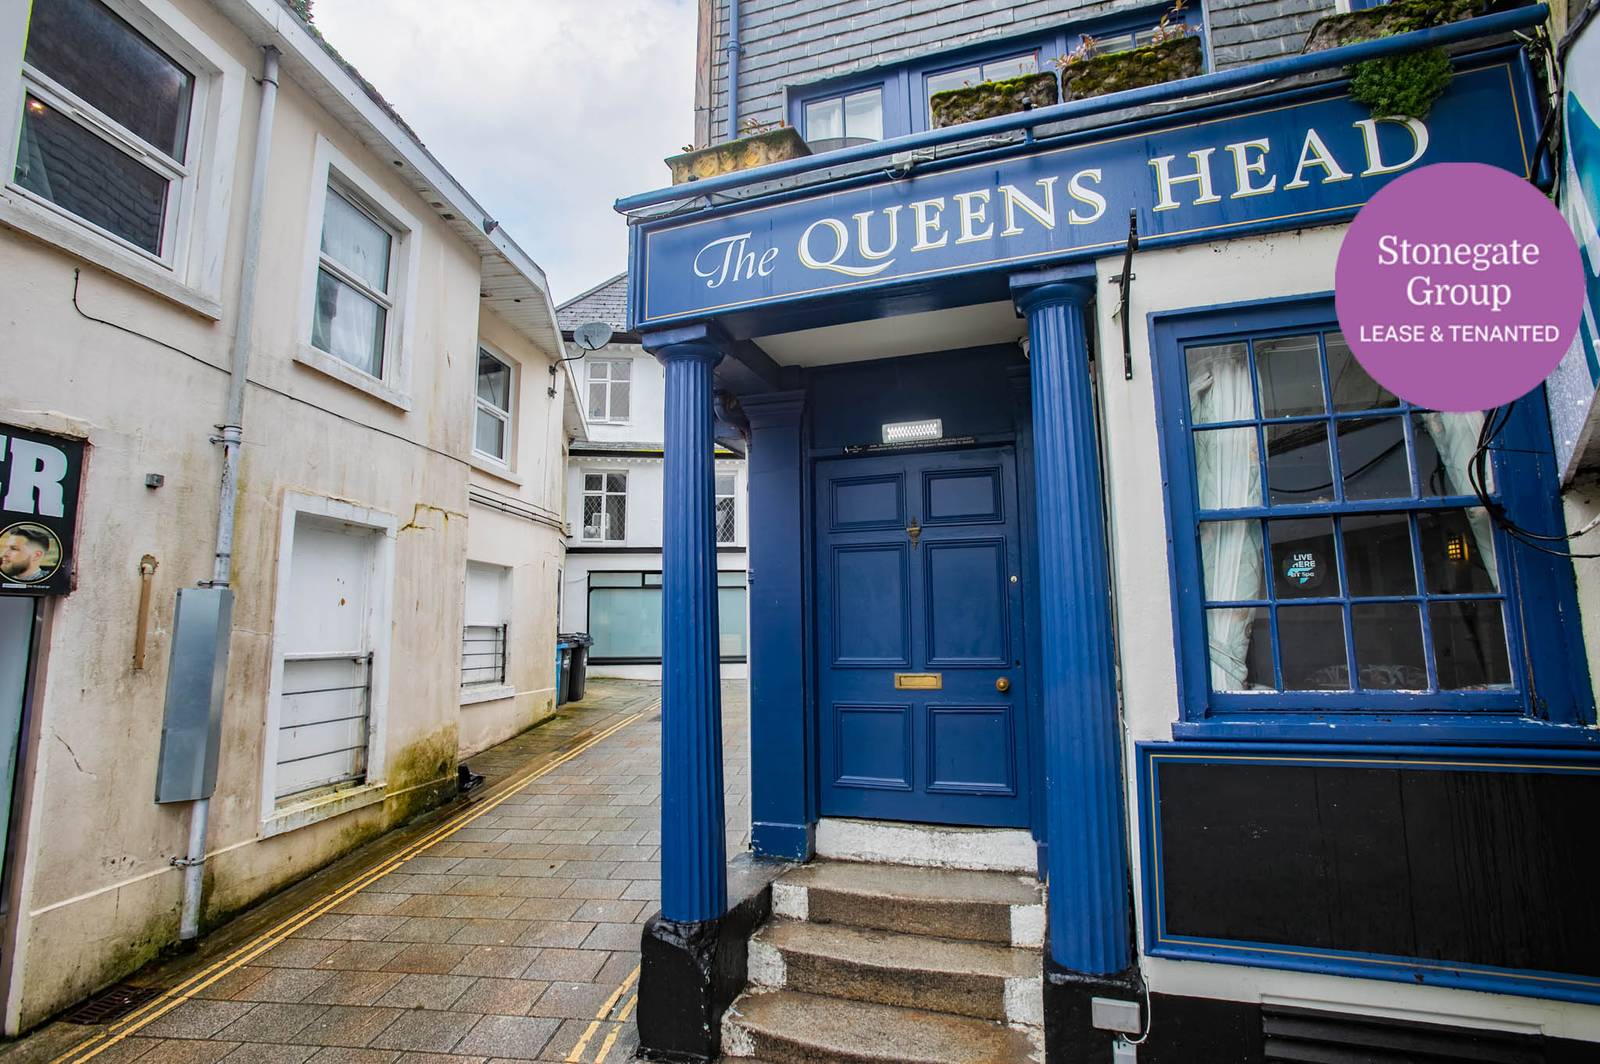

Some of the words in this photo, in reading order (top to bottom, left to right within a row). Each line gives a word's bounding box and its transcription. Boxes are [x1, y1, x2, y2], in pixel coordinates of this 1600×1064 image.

[693, 231, 779, 288] The
[798, 169, 1107, 277] QUEENS
[1147, 114, 1430, 213] HEAD
